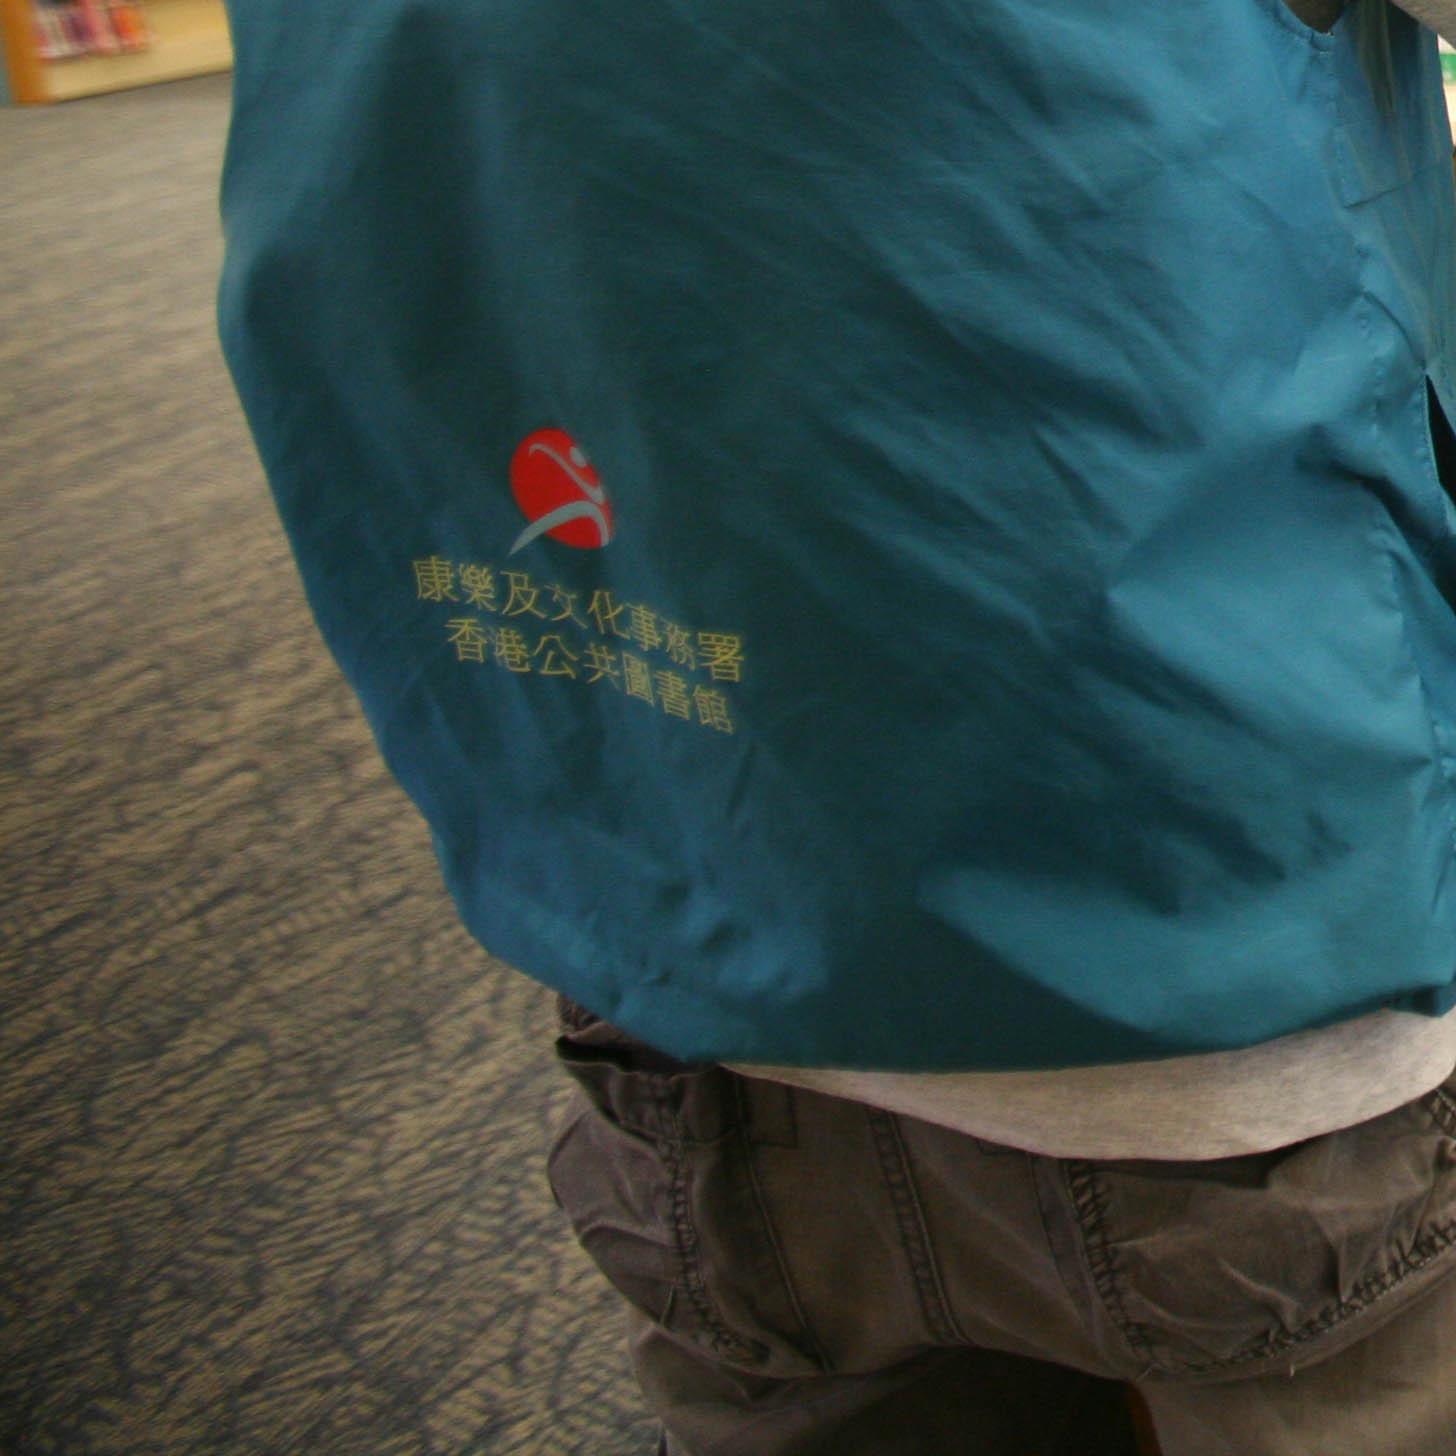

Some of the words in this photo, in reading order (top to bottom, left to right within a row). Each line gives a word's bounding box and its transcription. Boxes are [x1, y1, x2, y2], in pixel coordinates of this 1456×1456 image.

[412, 555, 744, 684] 康樂及文化事務署
[445, 617, 735, 734] 香港公共圖書館
